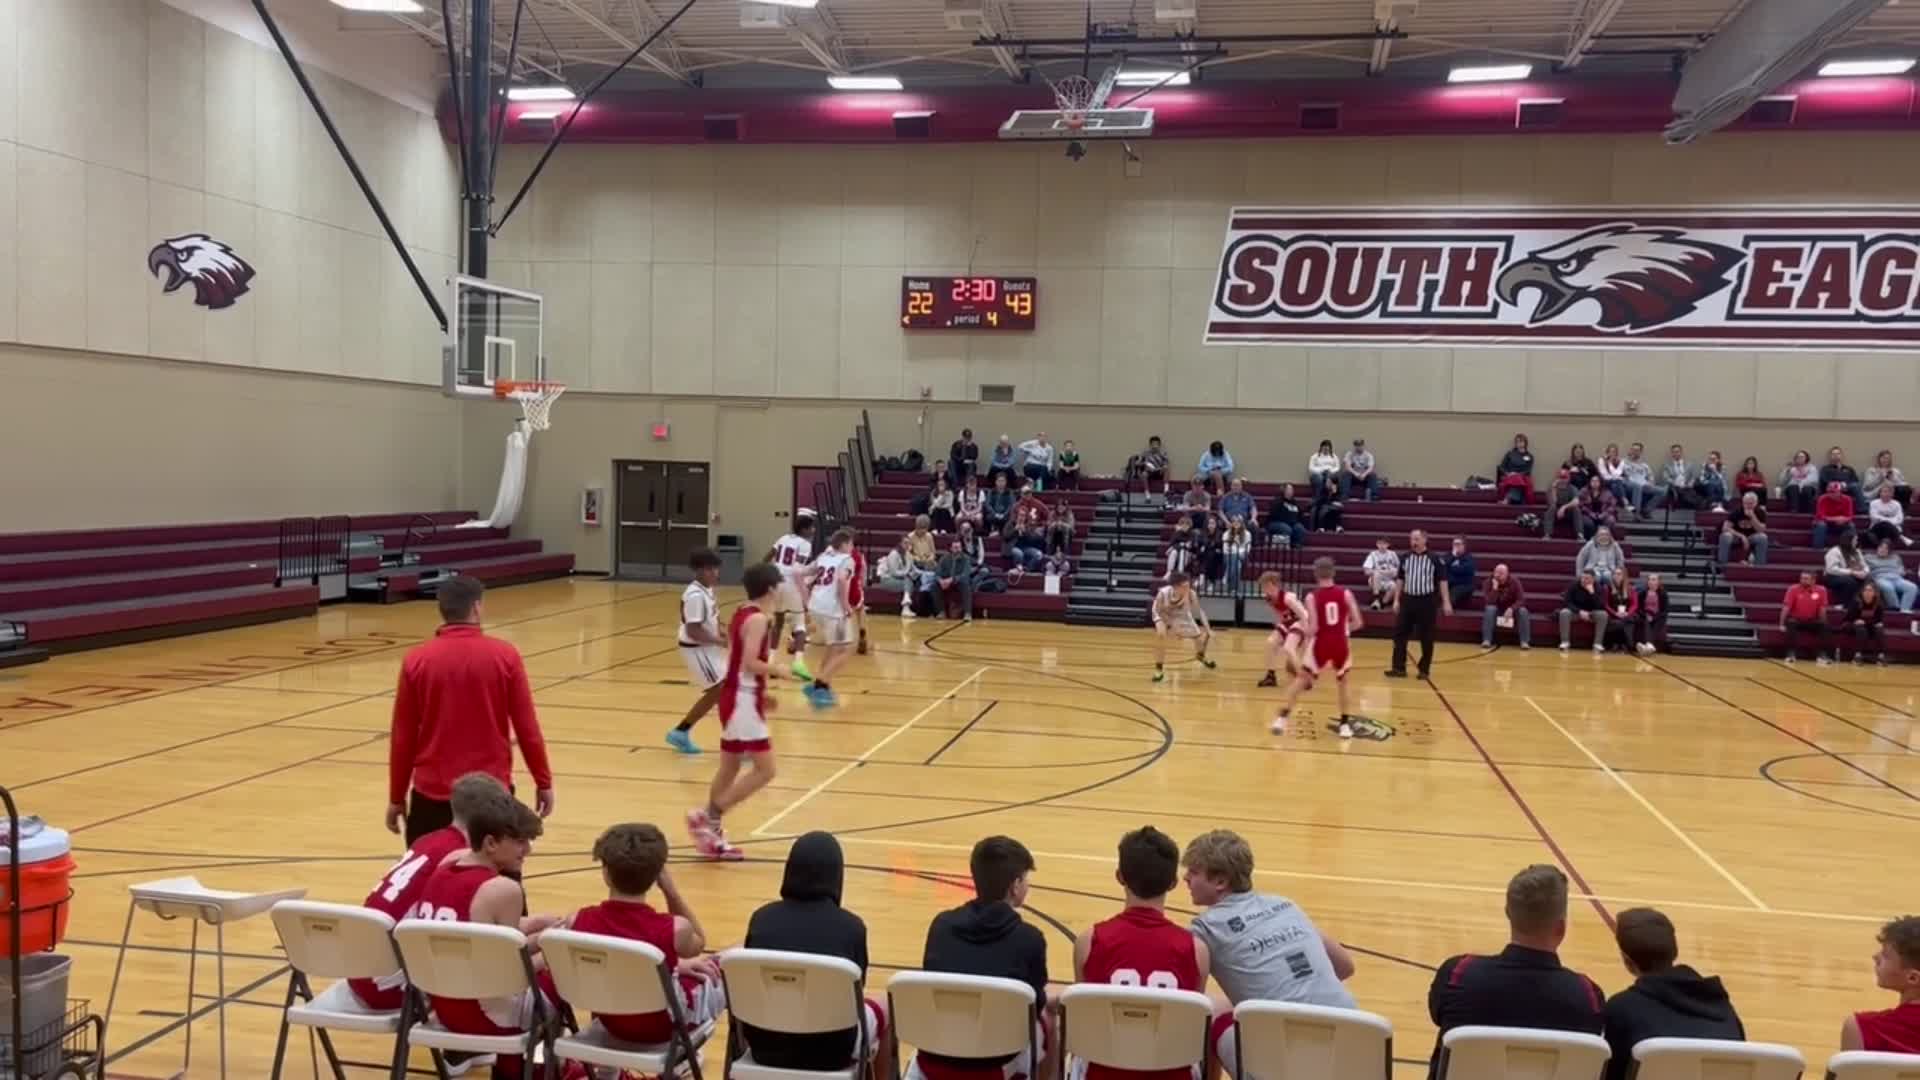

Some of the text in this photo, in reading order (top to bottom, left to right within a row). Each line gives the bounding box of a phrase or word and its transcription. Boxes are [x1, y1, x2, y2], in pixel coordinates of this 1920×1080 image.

[908, 280, 931, 290] Home
[1003, 280, 1032, 291] Guests
[1219, 236, 1512, 317] SOUTH
[1730, 237, 1920, 320] EAG
[952, 279, 996, 301] 2:30
[907, 292, 934, 314] 22
[1005, 293, 1032, 315] 43
[954, 311, 998, 326] period 4
[1324, 601, 1340, 626] 0
